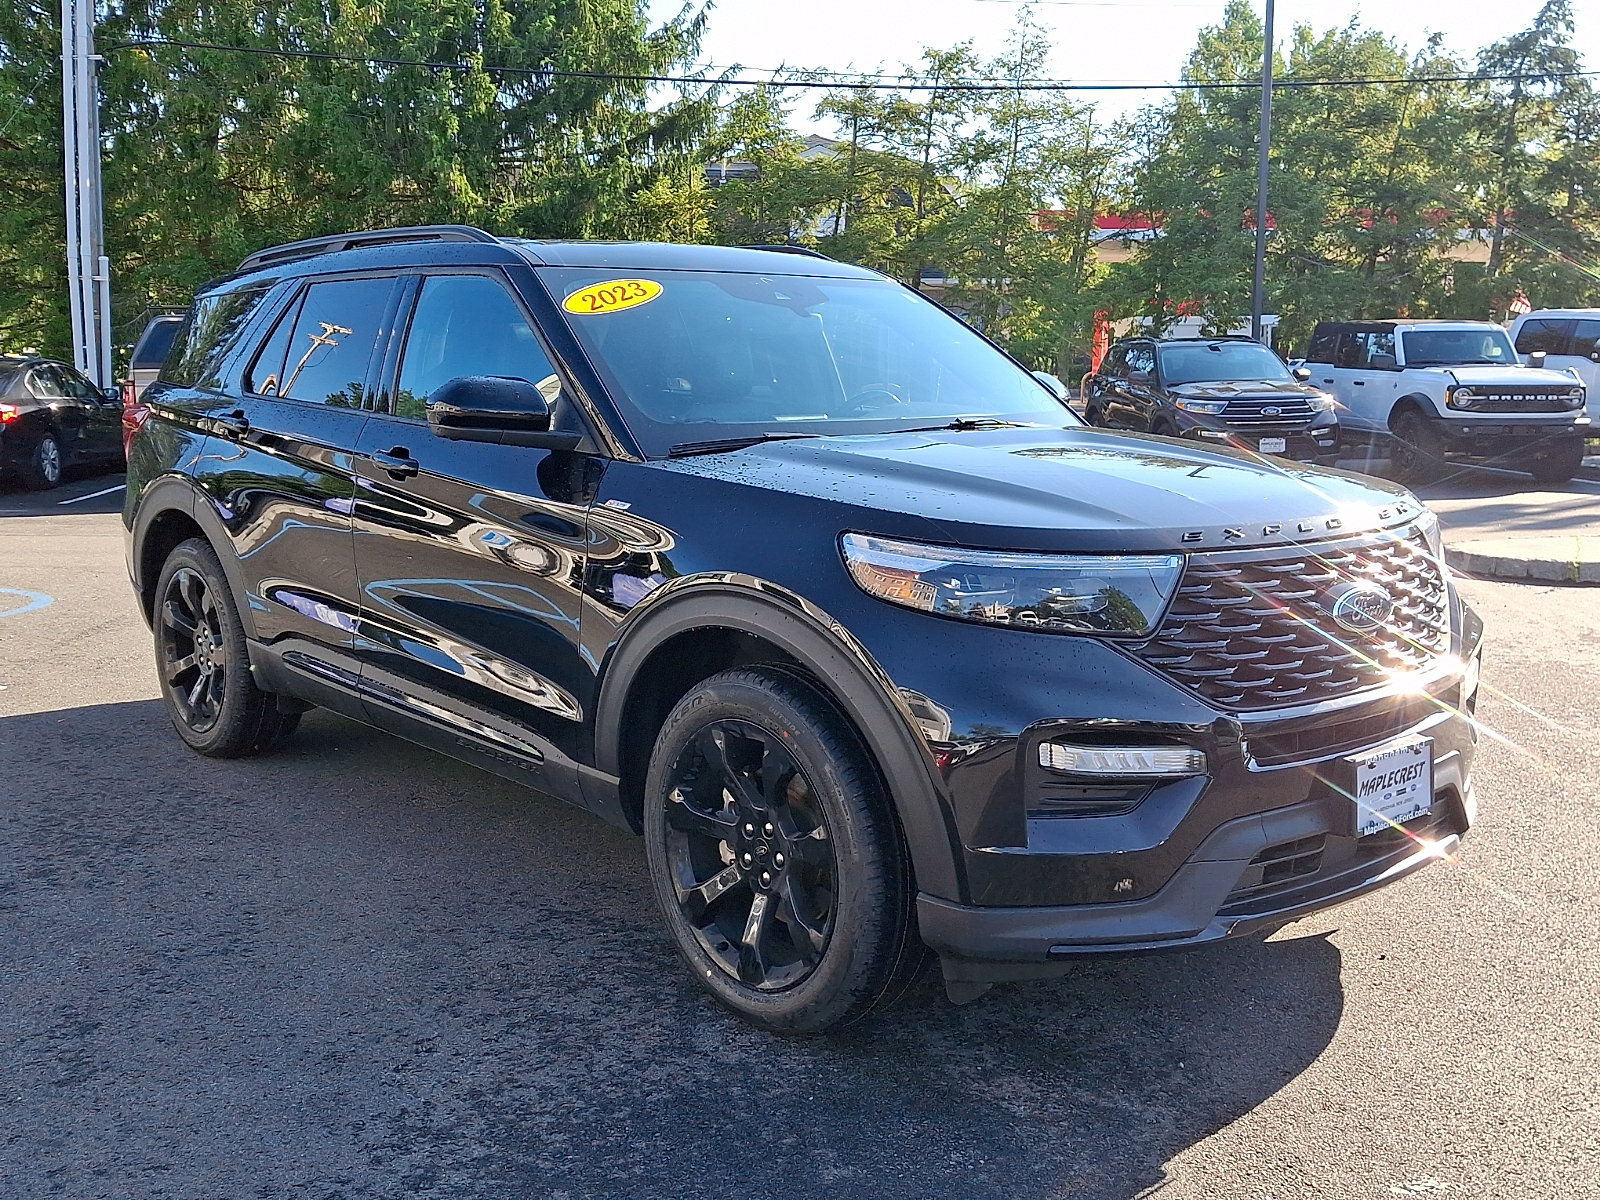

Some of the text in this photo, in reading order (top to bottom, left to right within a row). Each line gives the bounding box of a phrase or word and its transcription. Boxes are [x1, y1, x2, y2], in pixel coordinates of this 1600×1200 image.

[582, 282, 647, 310] 2023
[1181, 501, 1408, 543] EXPLOER
[1351, 595, 1384, 623] Ford
[1359, 761, 1426, 798] MAPLECREST
[1363, 808, 1428, 835] MaplecrstFord.com
